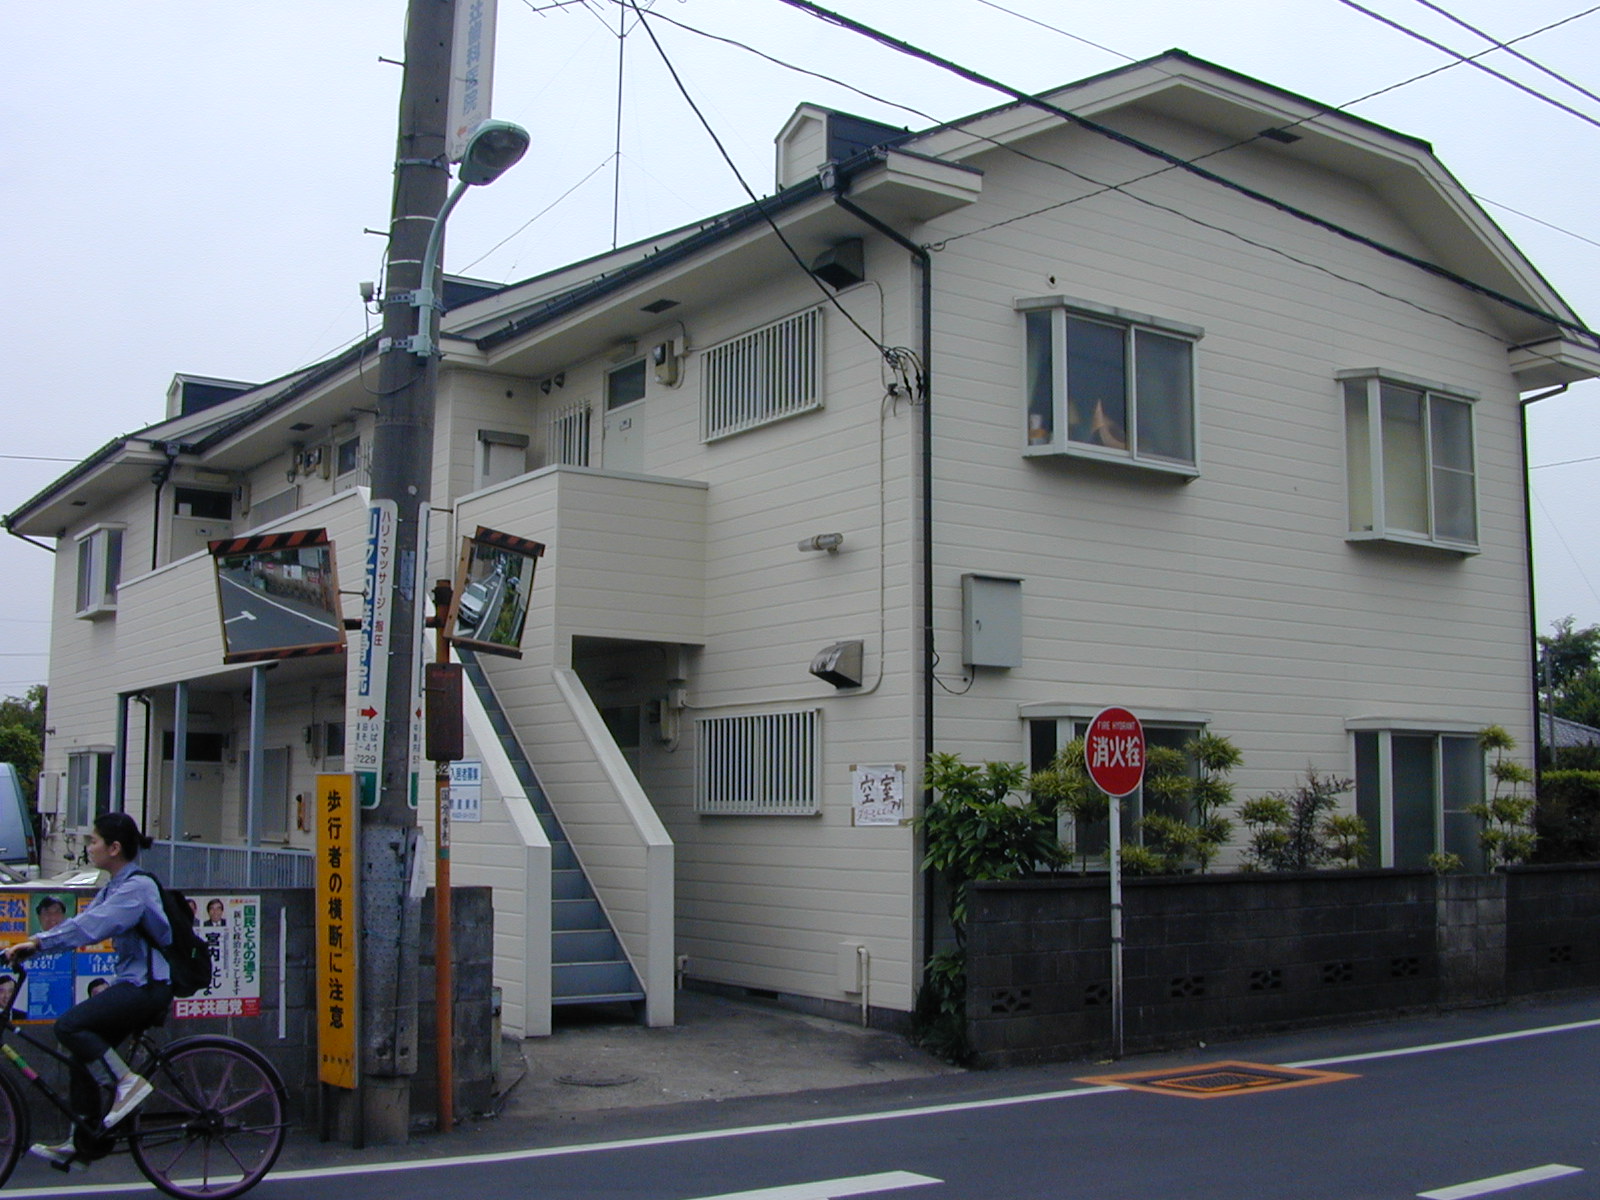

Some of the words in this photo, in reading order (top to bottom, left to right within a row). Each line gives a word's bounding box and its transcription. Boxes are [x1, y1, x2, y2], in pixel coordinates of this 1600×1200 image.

[1092, 735, 1141, 768] 消火栓
[860, 774, 895, 805] 空室
[327, 789, 345, 1029] 歩行者の横断に注意
[232, 910, 242, 996] 新しい政治をおこします
[243, 905, 257, 984] 国民と心の通う
[176, 999, 243, 1018] 日本共産党
